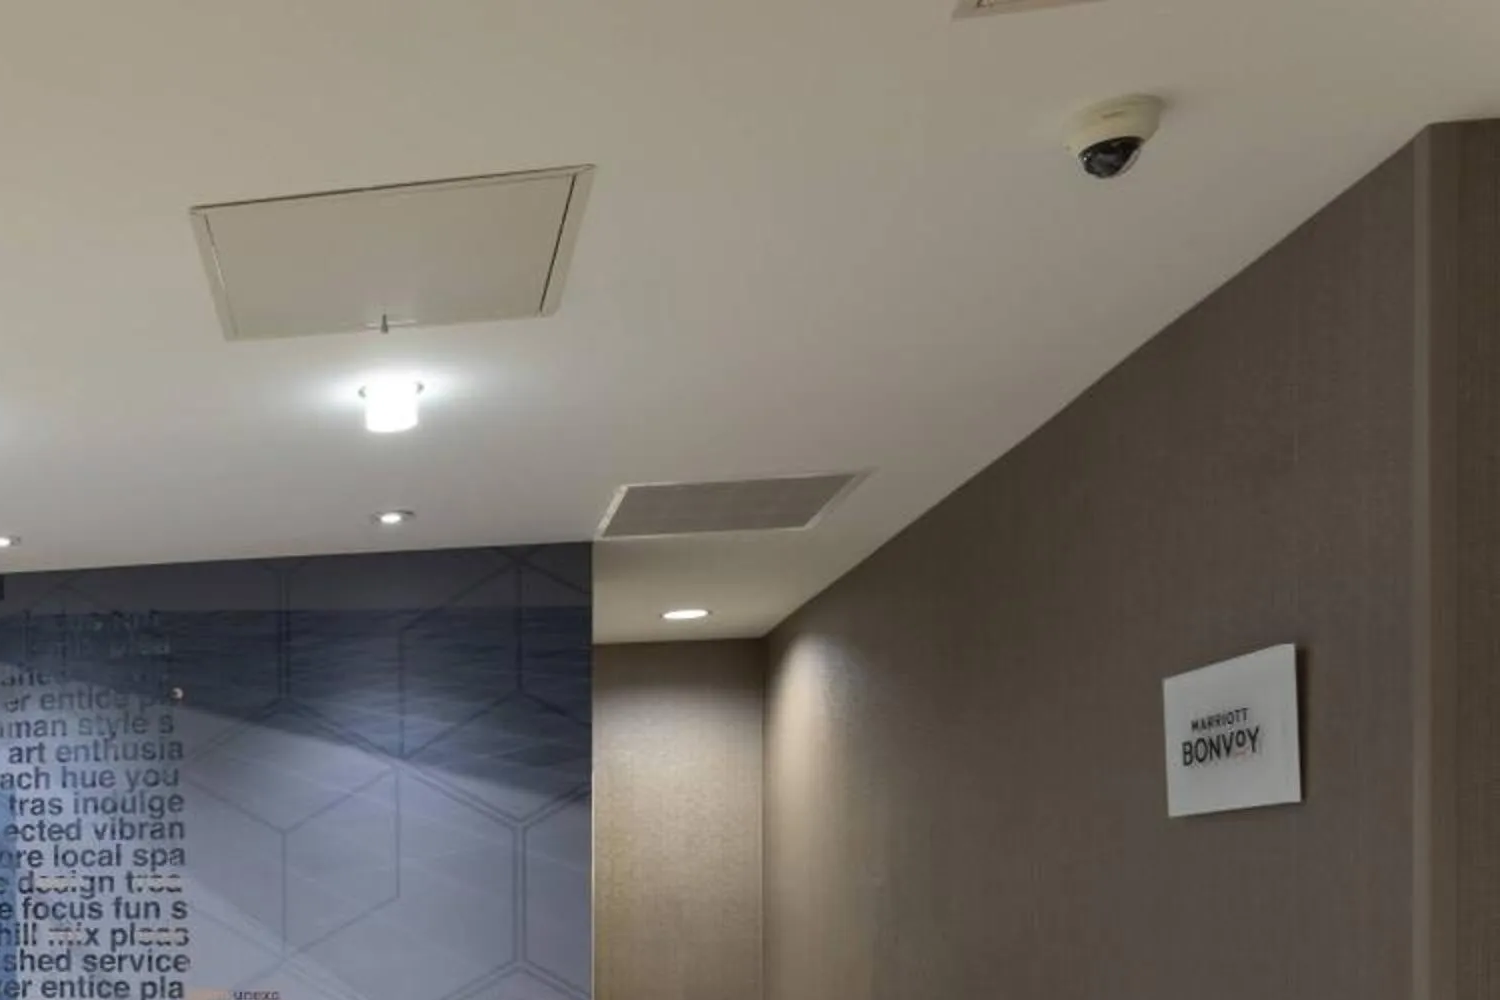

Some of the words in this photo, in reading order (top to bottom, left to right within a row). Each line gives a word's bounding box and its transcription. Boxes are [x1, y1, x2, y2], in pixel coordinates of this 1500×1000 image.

[78, 711, 150, 739] style
[1191, 707, 1250, 731] MARRIOTT
[8, 742, 47, 765] art
[55, 739, 184, 763] enthusia
[1182, 726, 1260, 767] BONVOY
[61, 766, 116, 789] hue
[125, 769, 180, 793] you
[3, 818, 82, 842] ected
[93, 817, 185, 840] vibran
[53, 844, 122, 867] local
[132, 849, 186, 873] spa
[21, 896, 104, 920] focus
[113, 896, 161, 920] fun
[170, 900, 189, 920] s
[82, 950, 191, 973] service
[41, 975, 131, 999] entice
